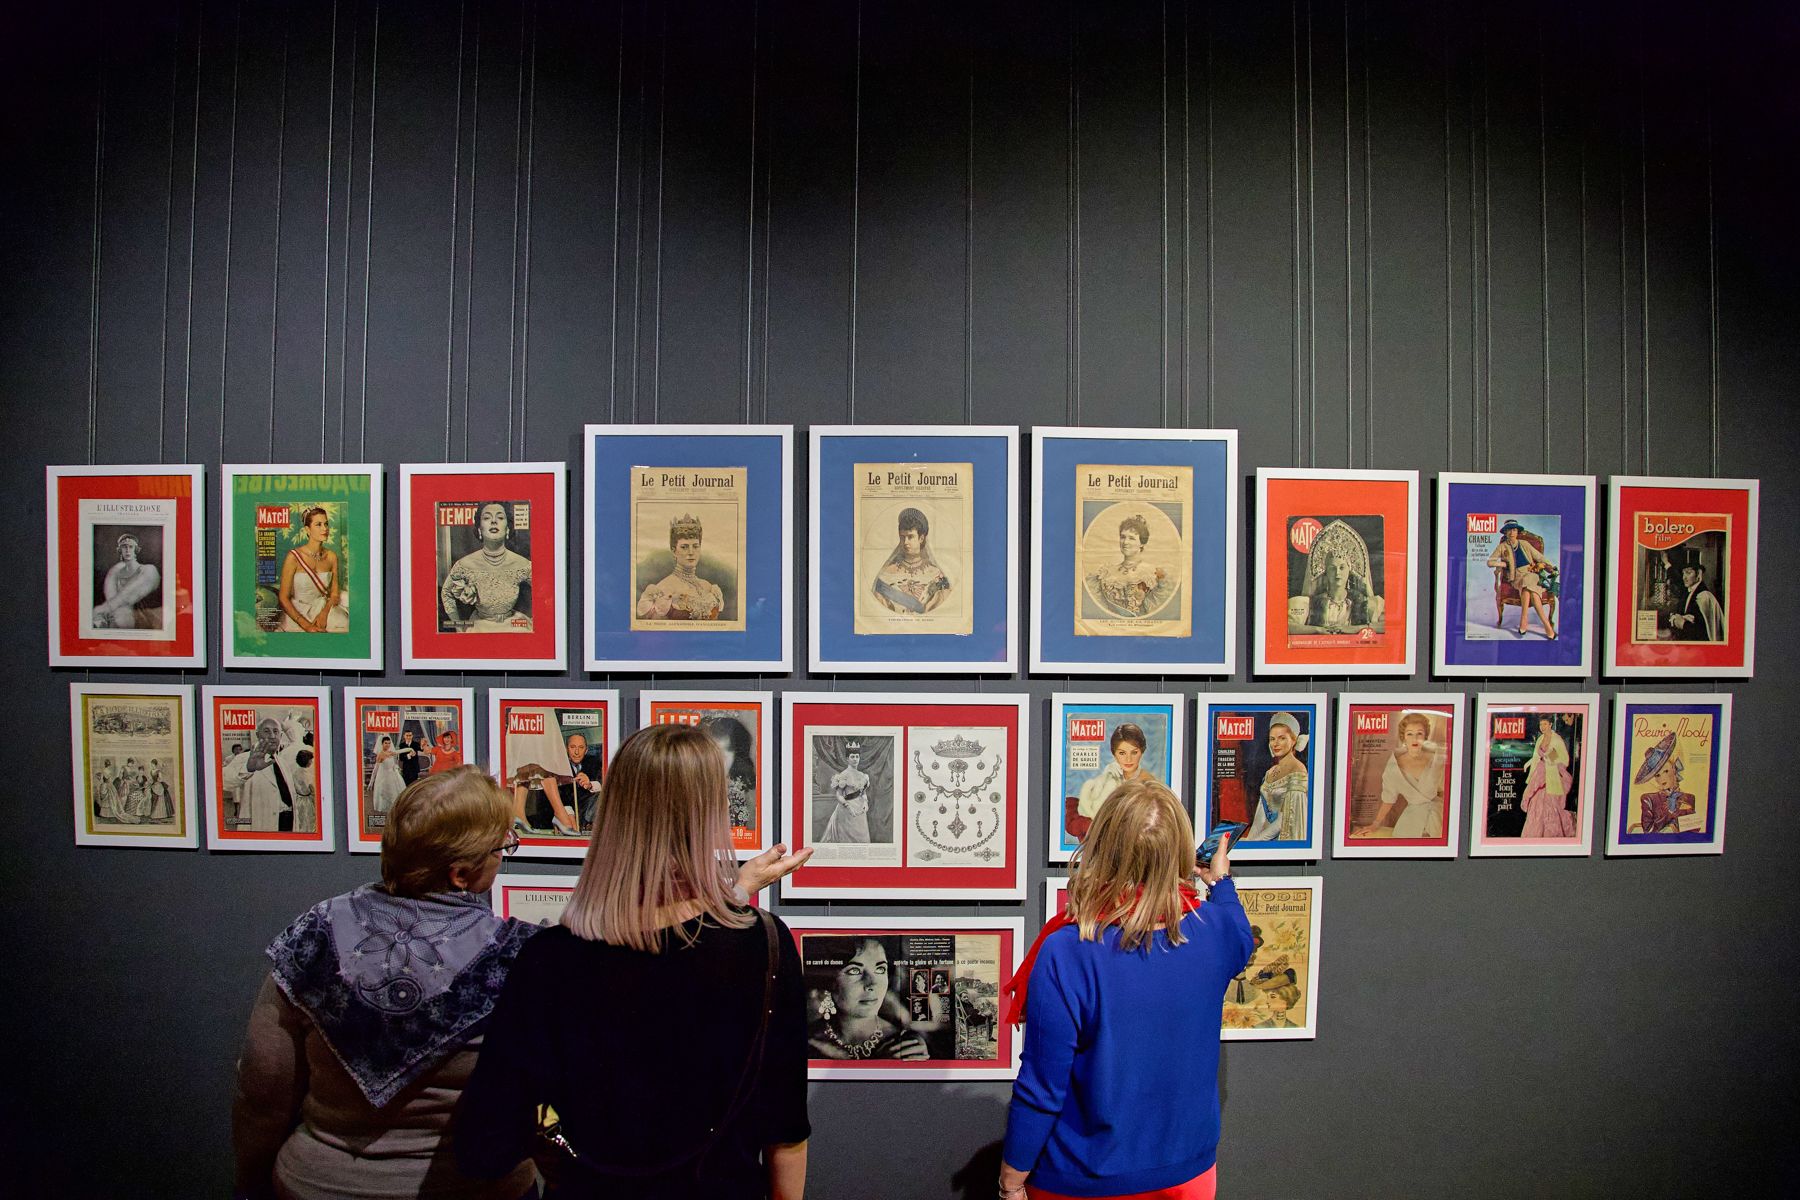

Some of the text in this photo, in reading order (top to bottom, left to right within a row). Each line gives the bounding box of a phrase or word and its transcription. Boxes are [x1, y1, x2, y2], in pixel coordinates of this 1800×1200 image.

[641, 473, 734, 488] Le Petit Journal
[868, 472, 958, 486] Le Petit Journal
[1087, 474, 1178, 489] Le Petit Journal
[1643, 517, 1695, 534] bolero
[1291, 522, 1321, 550] MATC
[1468, 534, 1492, 544] CHANEL
[1654, 534, 1672, 546] film
[1676, 717, 1710, 747] Mody
[525, 894, 570, 902] L'ILLUSTRA
[1265, 903, 1306, 912] Petit Journal
